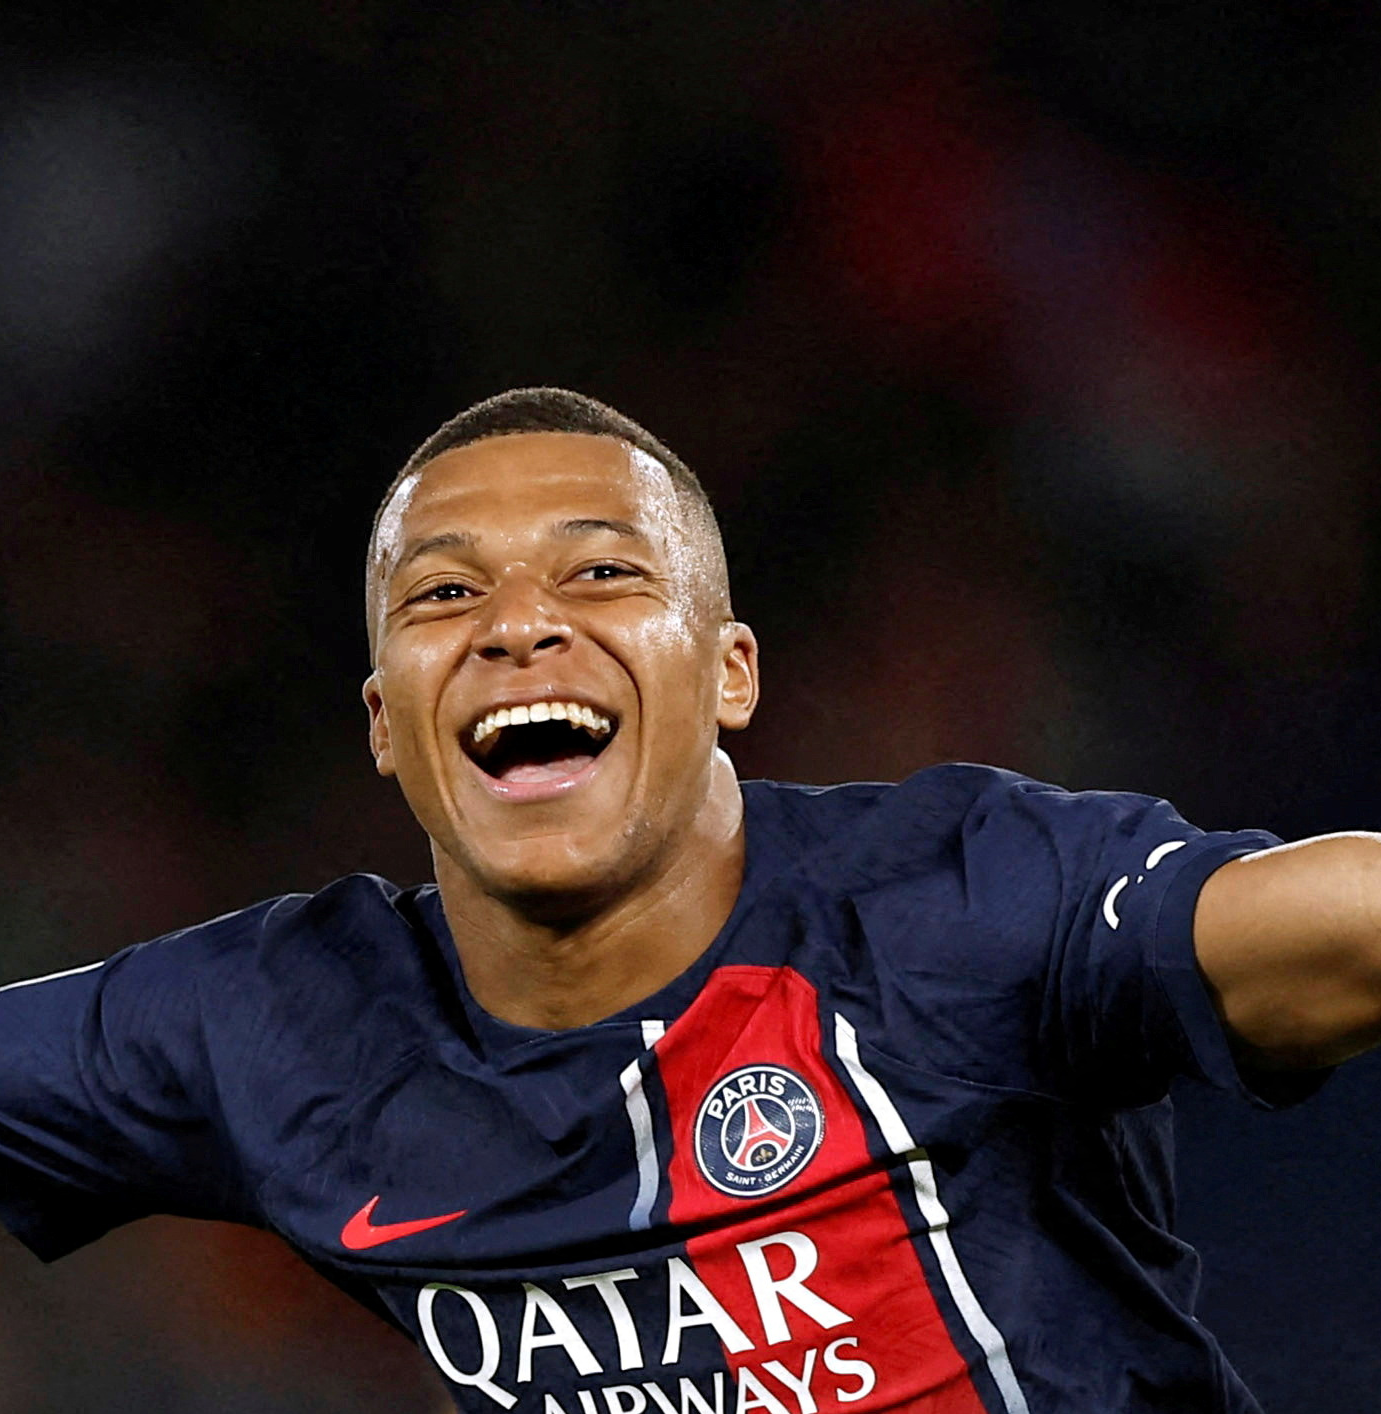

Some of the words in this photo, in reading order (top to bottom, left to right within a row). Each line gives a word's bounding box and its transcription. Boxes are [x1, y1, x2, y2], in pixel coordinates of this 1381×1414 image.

[707, 1073, 787, 1120] PARIS
[725, 1171, 756, 1186] SAINT
[417, 1230, 854, 1411] QATAR
